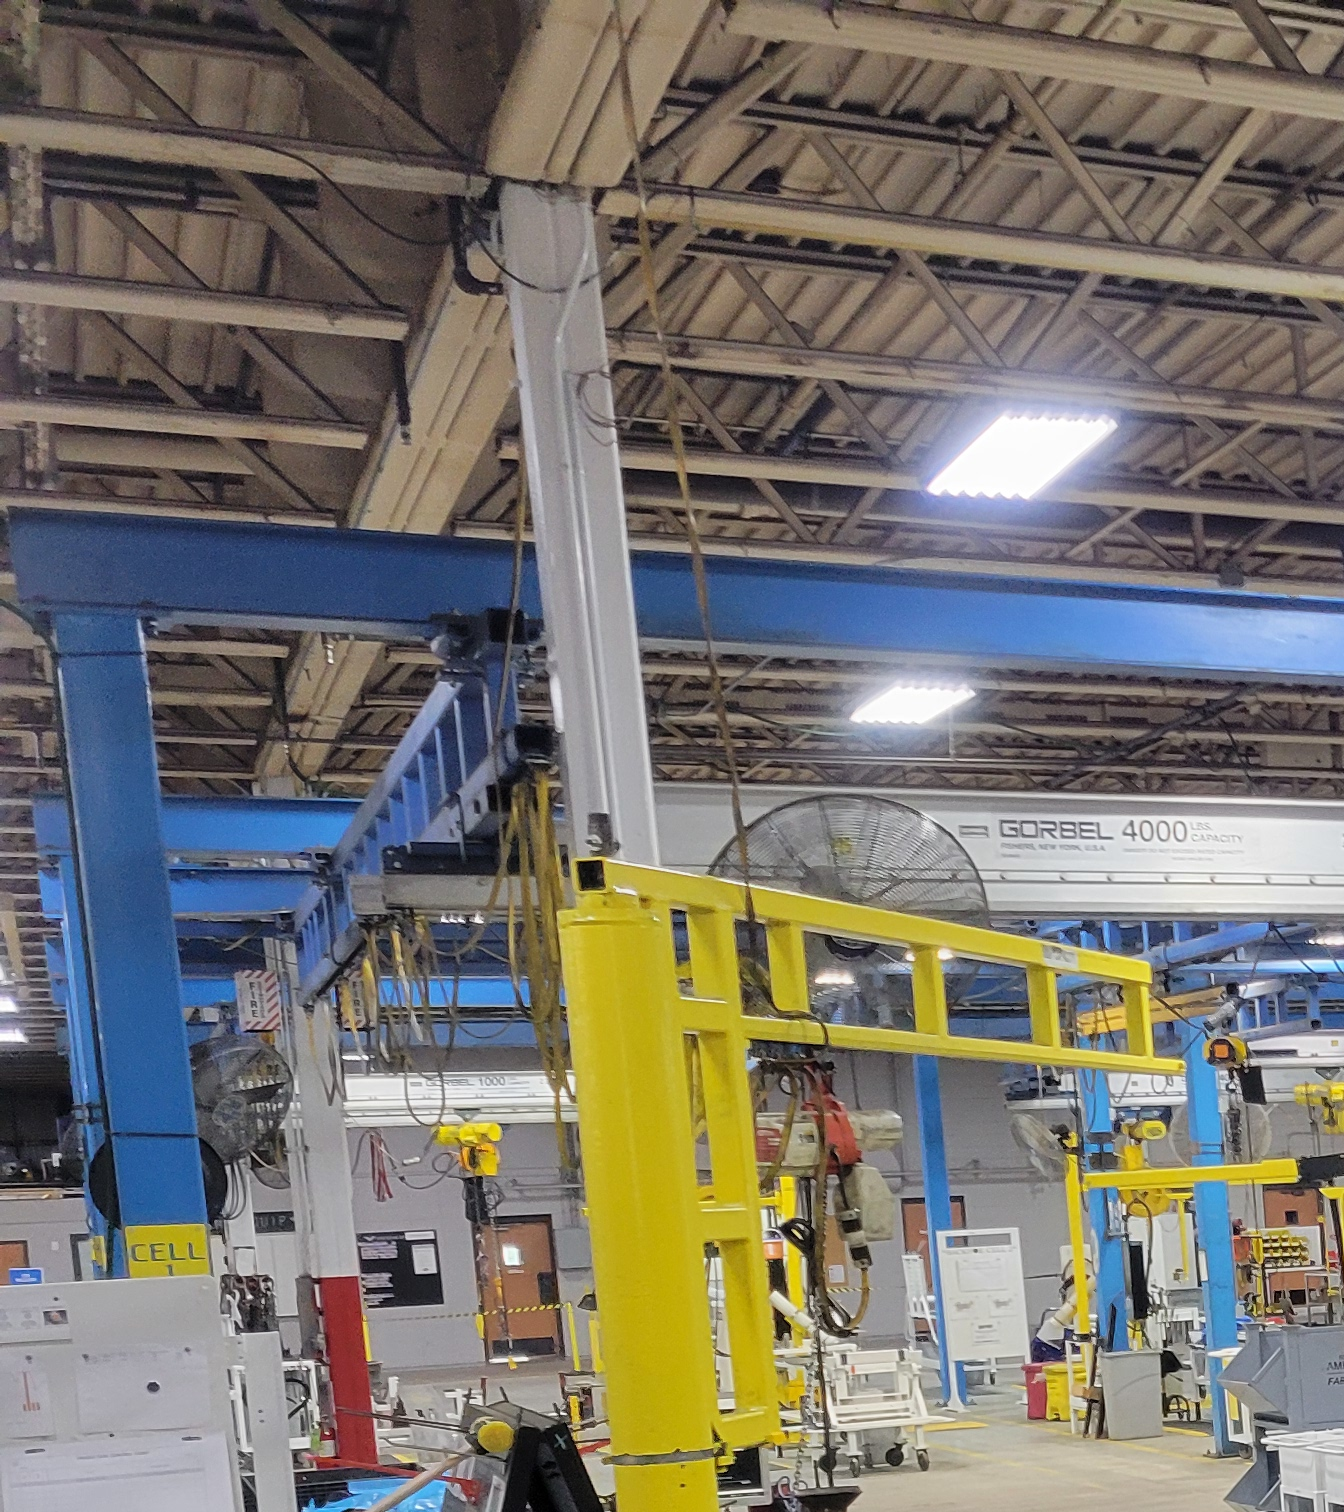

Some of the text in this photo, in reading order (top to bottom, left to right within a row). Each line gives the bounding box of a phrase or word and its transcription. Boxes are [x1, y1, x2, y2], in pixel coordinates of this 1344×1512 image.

[999, 820, 1114, 840] GORBEL
[1122, 819, 1188, 843] 4000
[1190, 833, 1244, 844] CAPACITY
[249, 981, 259, 1018] FIRE
[479, 1076, 506, 1087] 1000
[131, 1242, 206, 1262] CELL
[165, 1264, 174, 1277] 1
